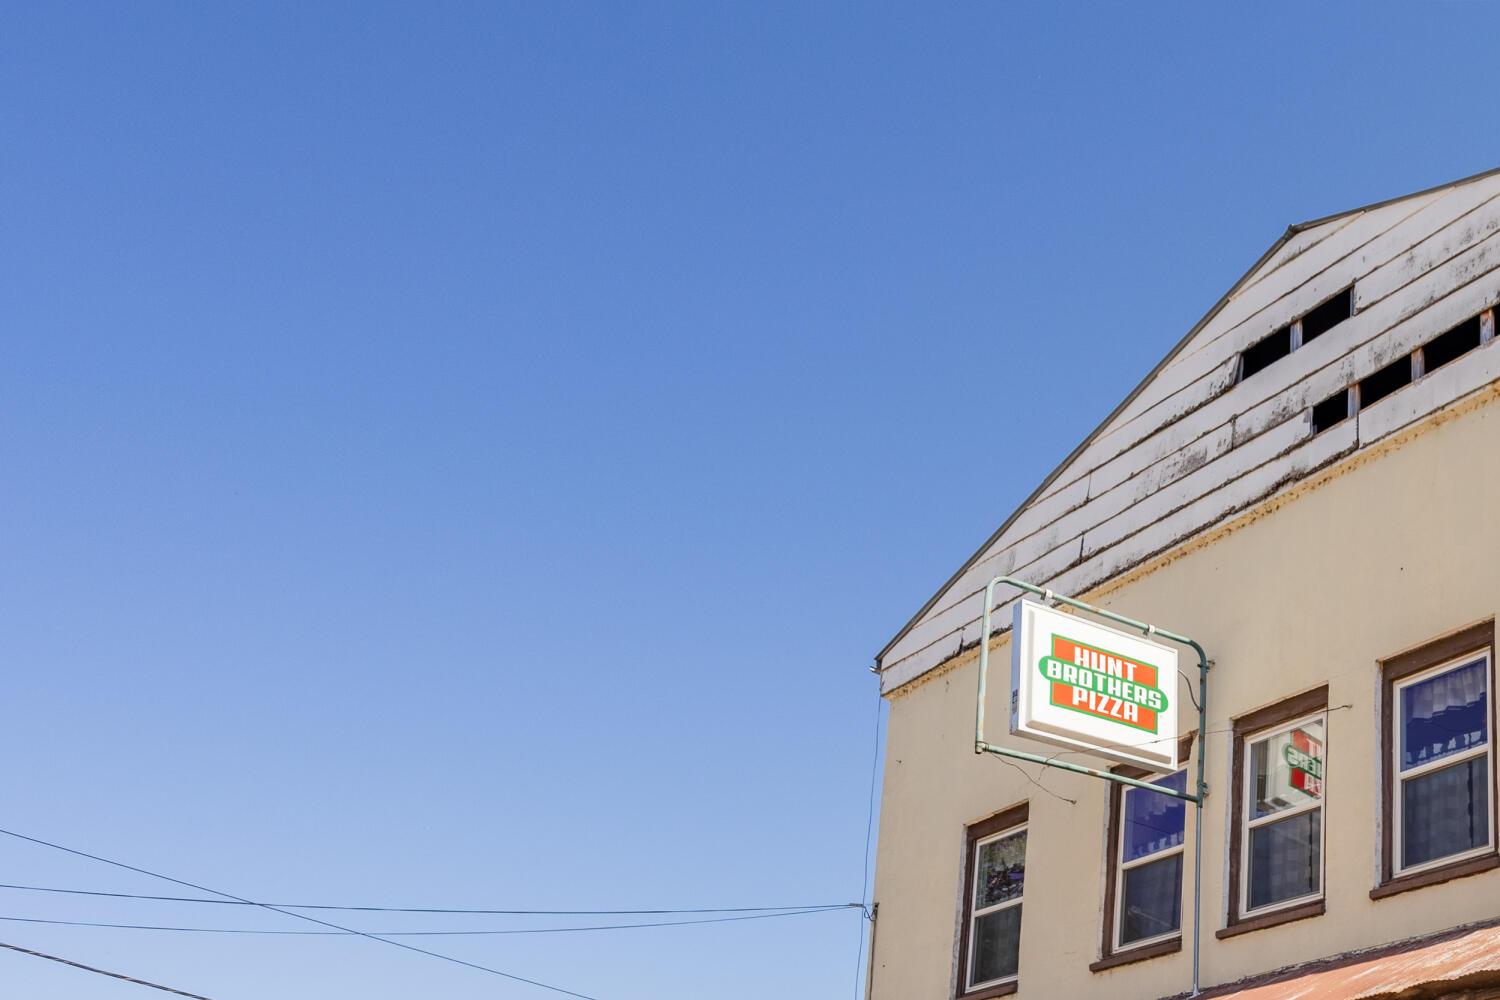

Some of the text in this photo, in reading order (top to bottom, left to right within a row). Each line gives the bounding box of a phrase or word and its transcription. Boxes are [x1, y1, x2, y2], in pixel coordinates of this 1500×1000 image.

[1074, 646, 1137, 682] HUNT
[1047, 658, 1162, 709] BROTHERS
[1072, 686, 1138, 723] PIZZA
